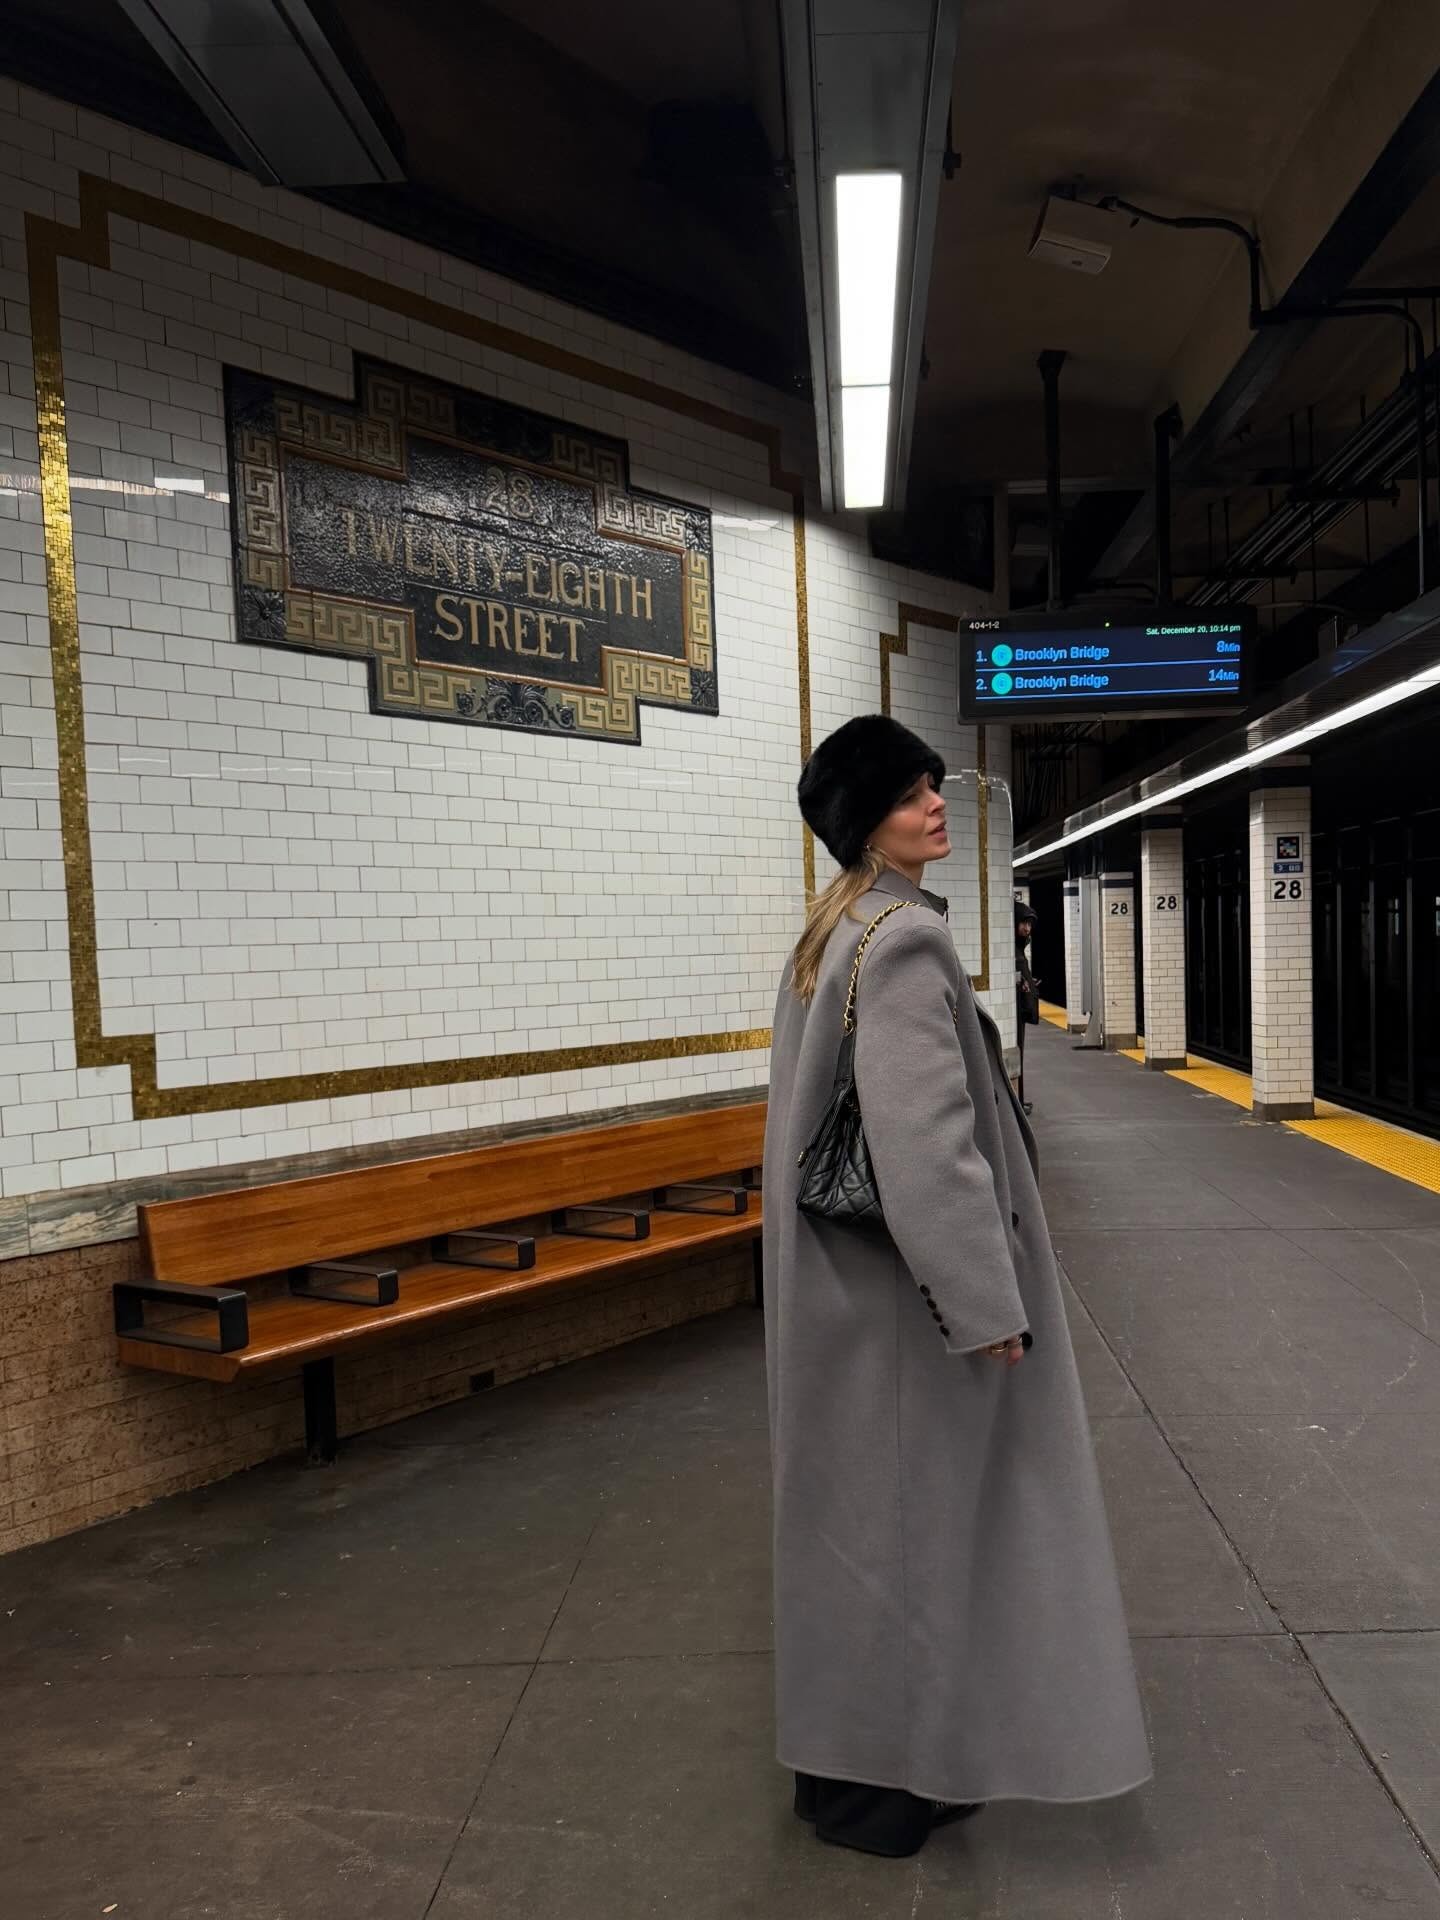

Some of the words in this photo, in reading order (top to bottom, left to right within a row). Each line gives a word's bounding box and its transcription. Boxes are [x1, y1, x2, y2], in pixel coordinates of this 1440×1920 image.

[485, 467, 536, 519] 28
[338, 508, 653, 620] TWENTY-EIGHTH
[434, 594, 585, 663] STREET
[969, 621, 1000, 629] 404-1-2
[1161, 627, 1195, 635] December
[1209, 624, 1228, 632] 10:14
[1229, 625, 1240, 633] pm
[976, 650, 988, 662] 1.
[1015, 647, 1067, 662] Brooklyn
[1070, 646, 1109, 660] Bridge
[976, 679, 988, 690] 2.
[1015, 675, 1066, 690] Brooklyn
[1069, 674, 1109, 688] Bridge
[1274, 880, 1302, 900] 28
[1111, 902, 1128, 915] 28
[1157, 896, 1177, 910] 28
